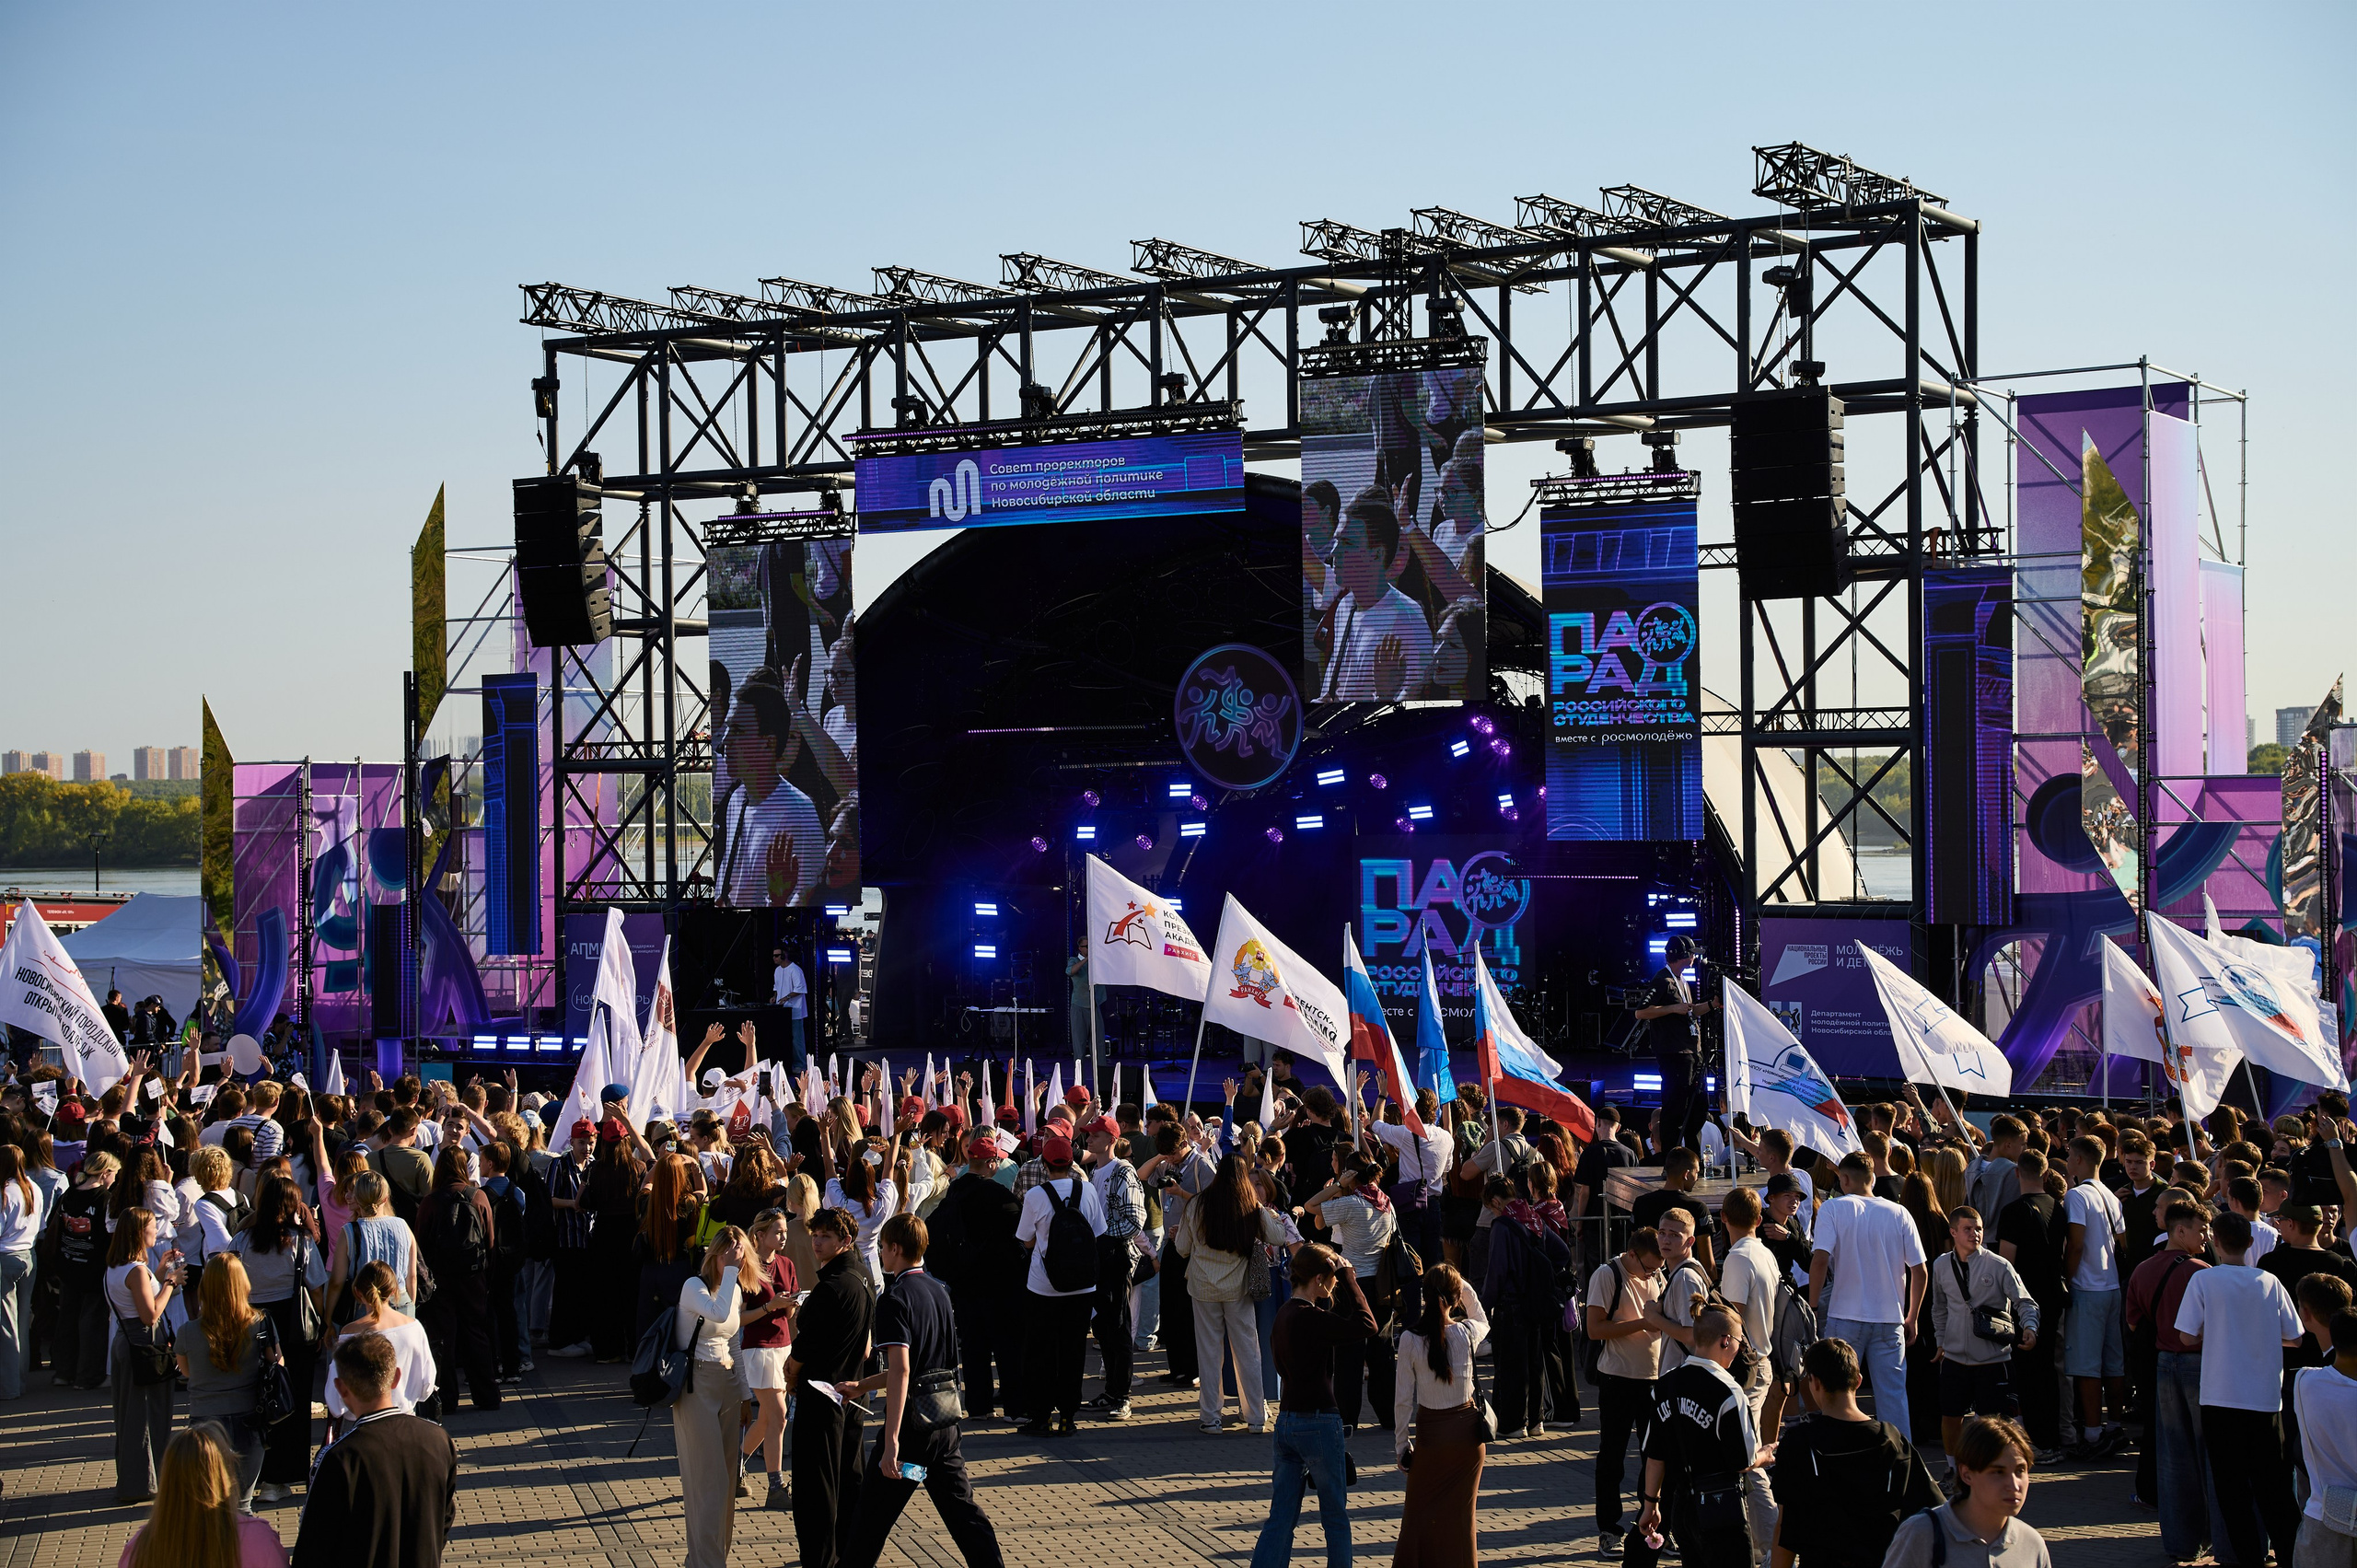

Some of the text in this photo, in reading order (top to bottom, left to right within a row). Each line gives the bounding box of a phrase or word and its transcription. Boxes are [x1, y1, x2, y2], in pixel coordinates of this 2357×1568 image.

[990, 457, 1125, 475] Совет проректоров
[991, 470, 1164, 492] по молодёжной политике
[992, 488, 1155, 508] Новосибирской области
[1552, 698, 1686, 713] РОССИЙСКОГО
[1553, 711, 1695, 726] СТУДЕНЧЕСТВА
[1555, 735, 1588, 743] вместе
[1601, 730, 1693, 746] росмолодёжь
[1836, 945, 1903, 956] МОЛДЁЖЬ
[1836, 958, 1867, 969] И ДЕТ
[1382, 1007, 1414, 1016] есте с
[1811, 1018, 1861, 1027] молодёжной
[1811, 1027, 1872, 1036] Новосибирской
